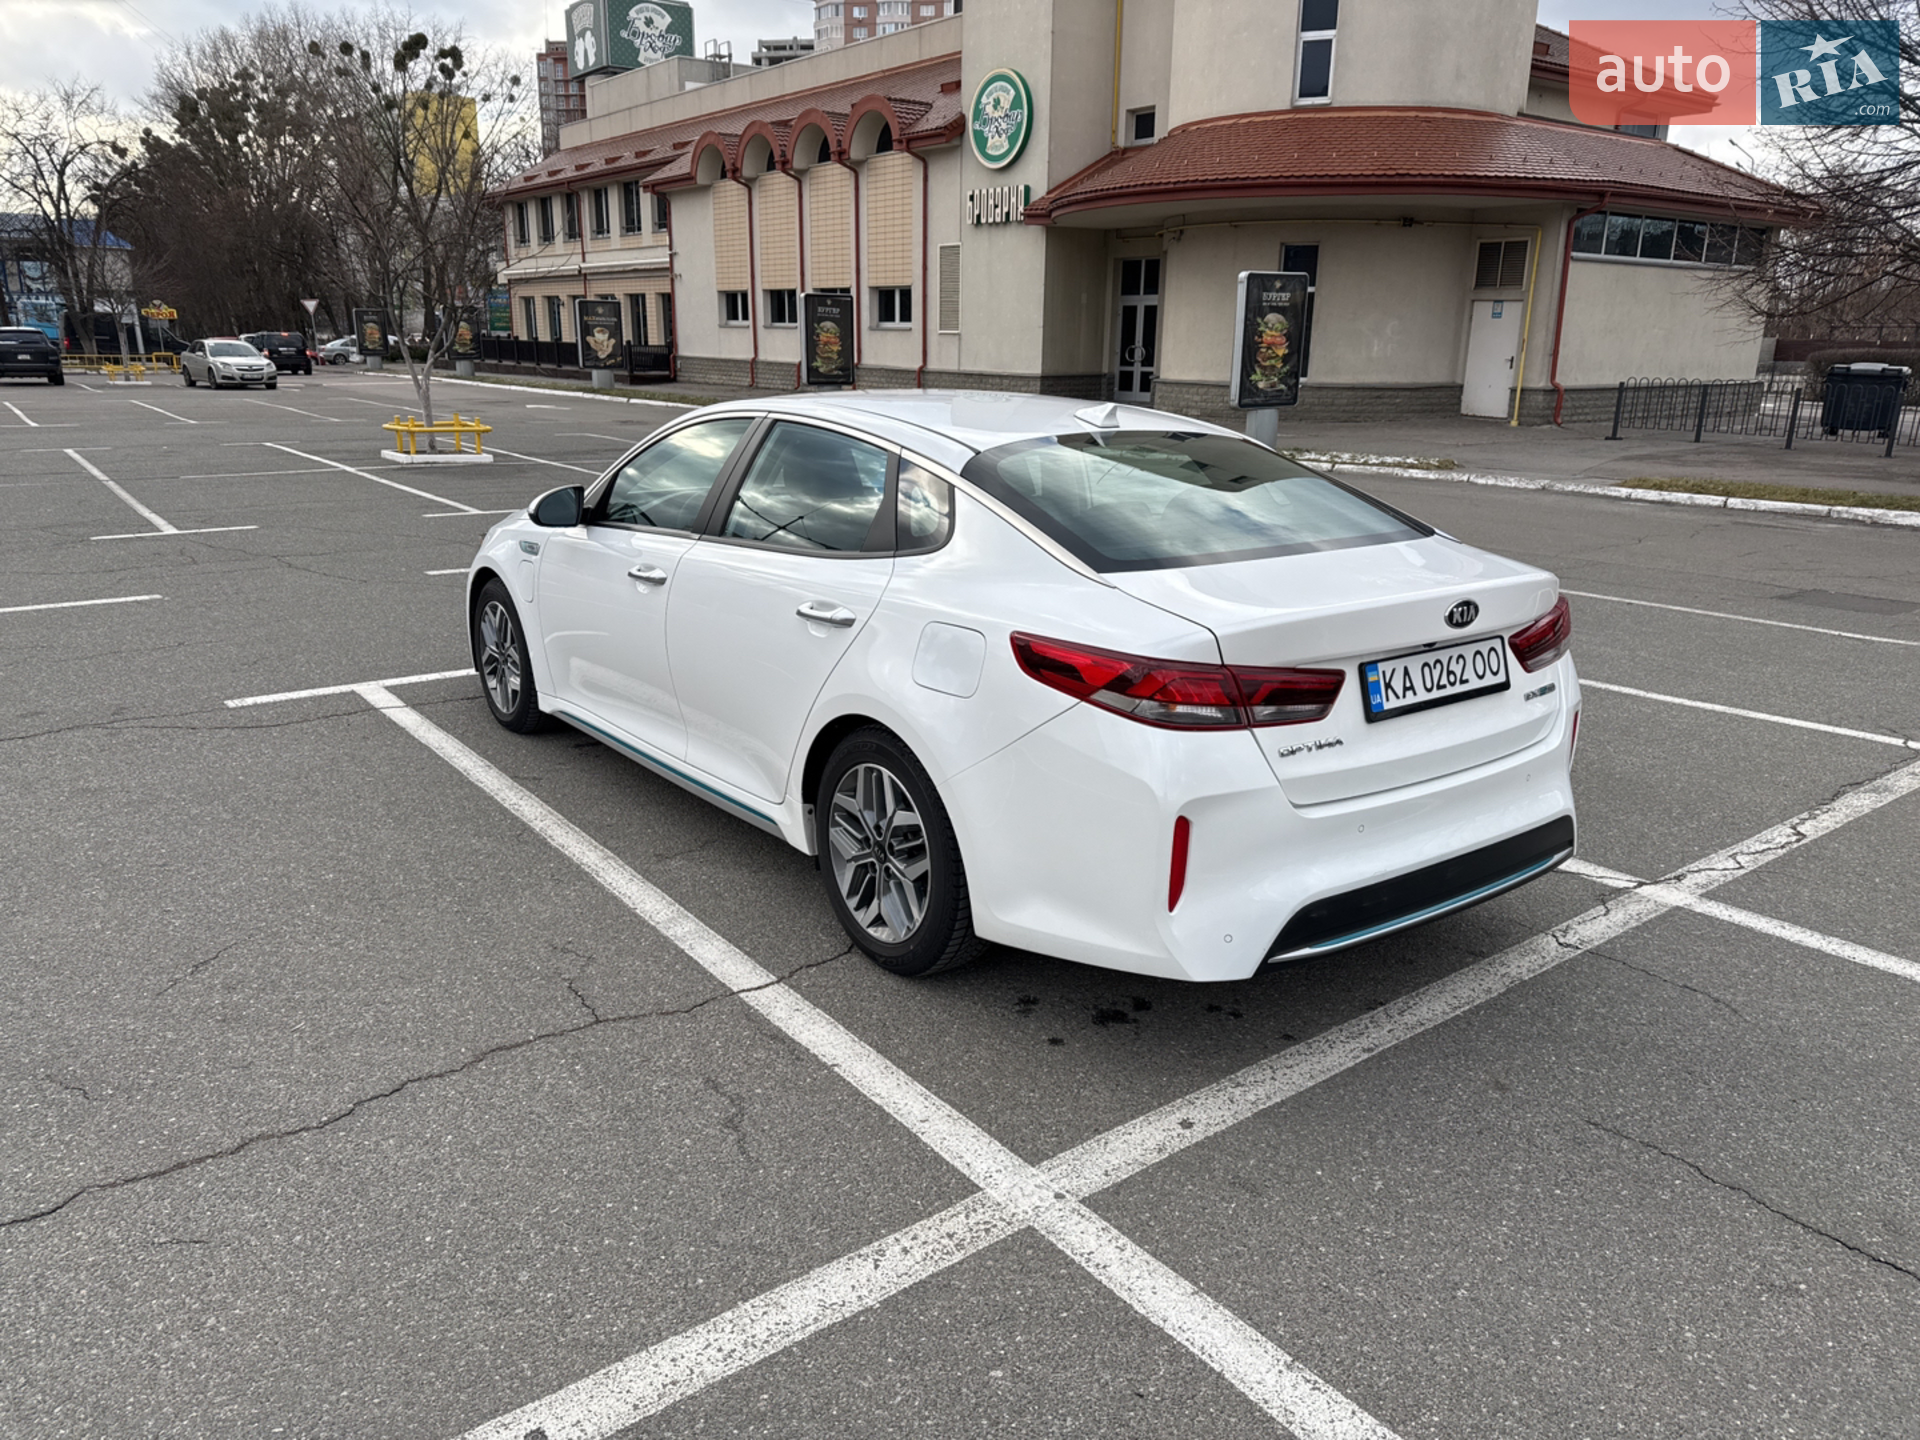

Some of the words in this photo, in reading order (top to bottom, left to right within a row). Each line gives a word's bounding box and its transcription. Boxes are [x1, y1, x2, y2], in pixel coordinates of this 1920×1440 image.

[1452, 604, 1476, 624] KIA
[1382, 665, 1417, 702] KA
[1421, 653, 1469, 693] 0262
[1370, 693, 1383, 705] UA
